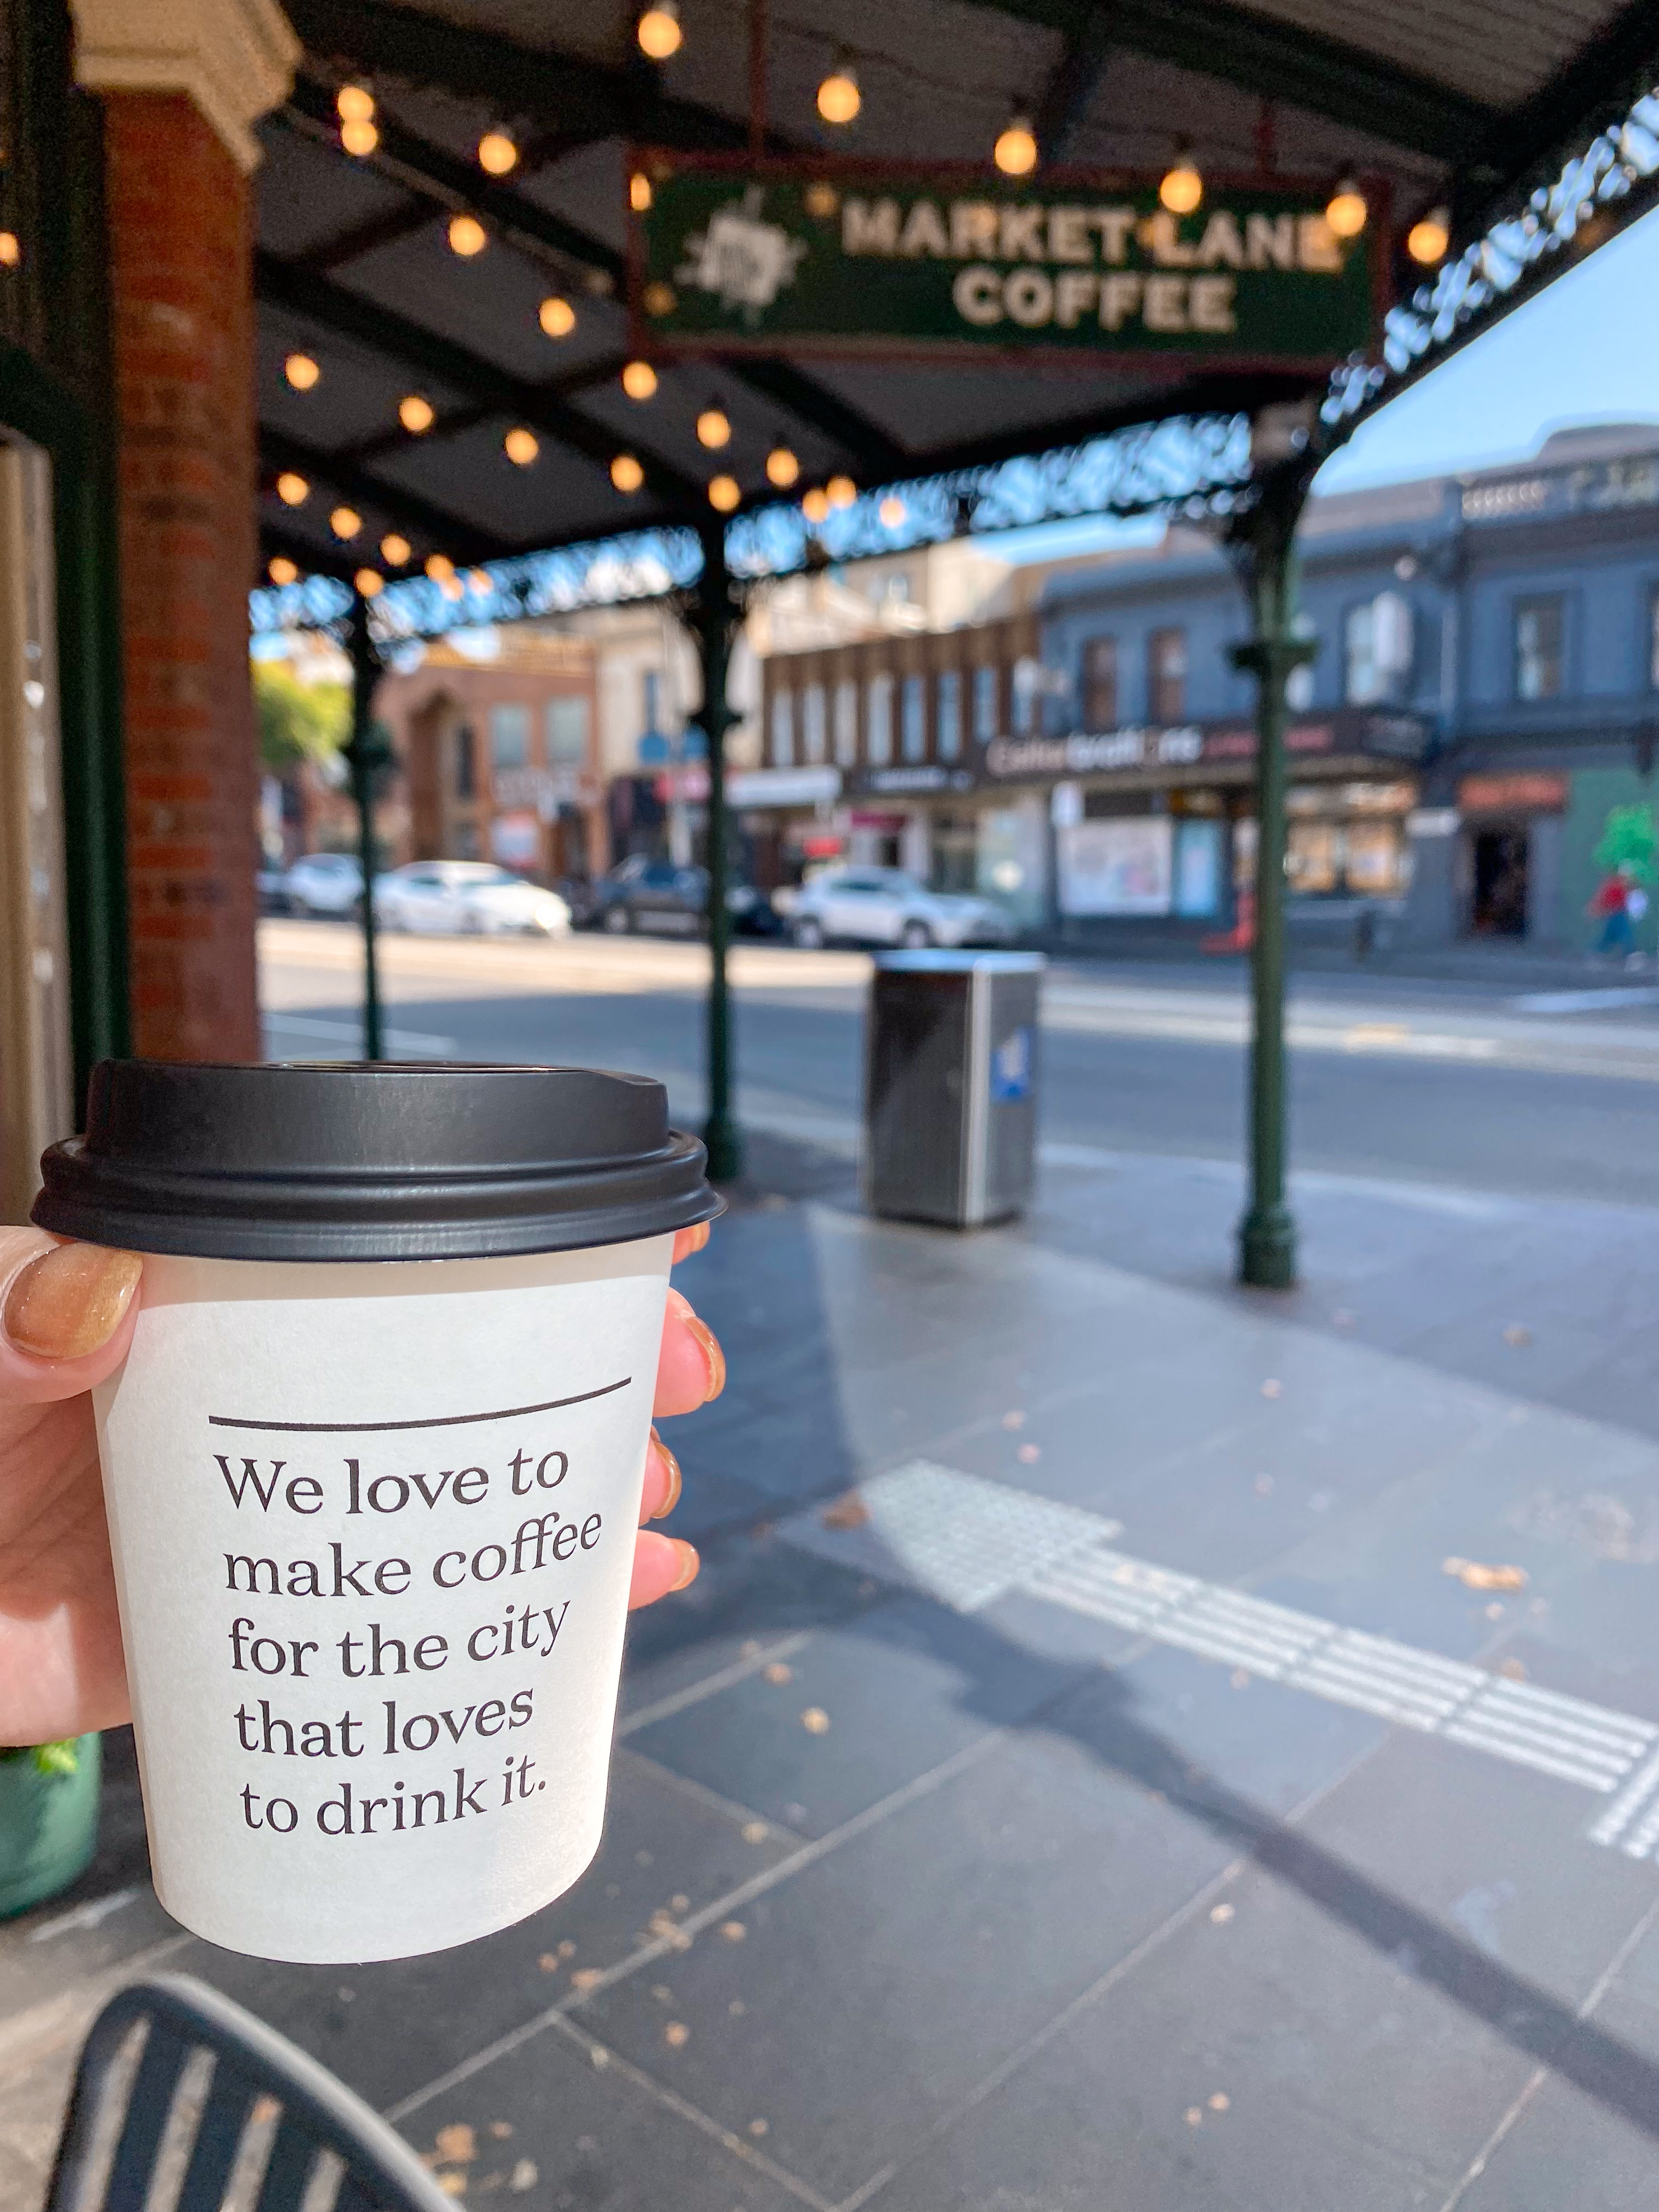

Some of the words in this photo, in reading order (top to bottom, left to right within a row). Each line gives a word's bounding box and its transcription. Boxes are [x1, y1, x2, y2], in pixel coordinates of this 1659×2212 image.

[841, 200, 1135, 264] MARKET
[1151, 211, 1342, 272] LANE
[953, 264, 1235, 331] COFFEE
[213, 1454, 324, 1514] We
[343, 1458, 489, 1514] love
[507, 1448, 568, 1496] to
[223, 1542, 411, 1598] make
[432, 1511, 602, 1589] coffee
[228, 1617, 319, 1678] for
[336, 1623, 449, 1678] the
[467, 1600, 571, 1661] city
[233, 1699, 365, 1758] that
[382, 1688, 533, 1755] loves
[240, 1782, 298, 1833] to
[317, 1767, 488, 1836] drink
[500, 1754, 546, 1807] it.
